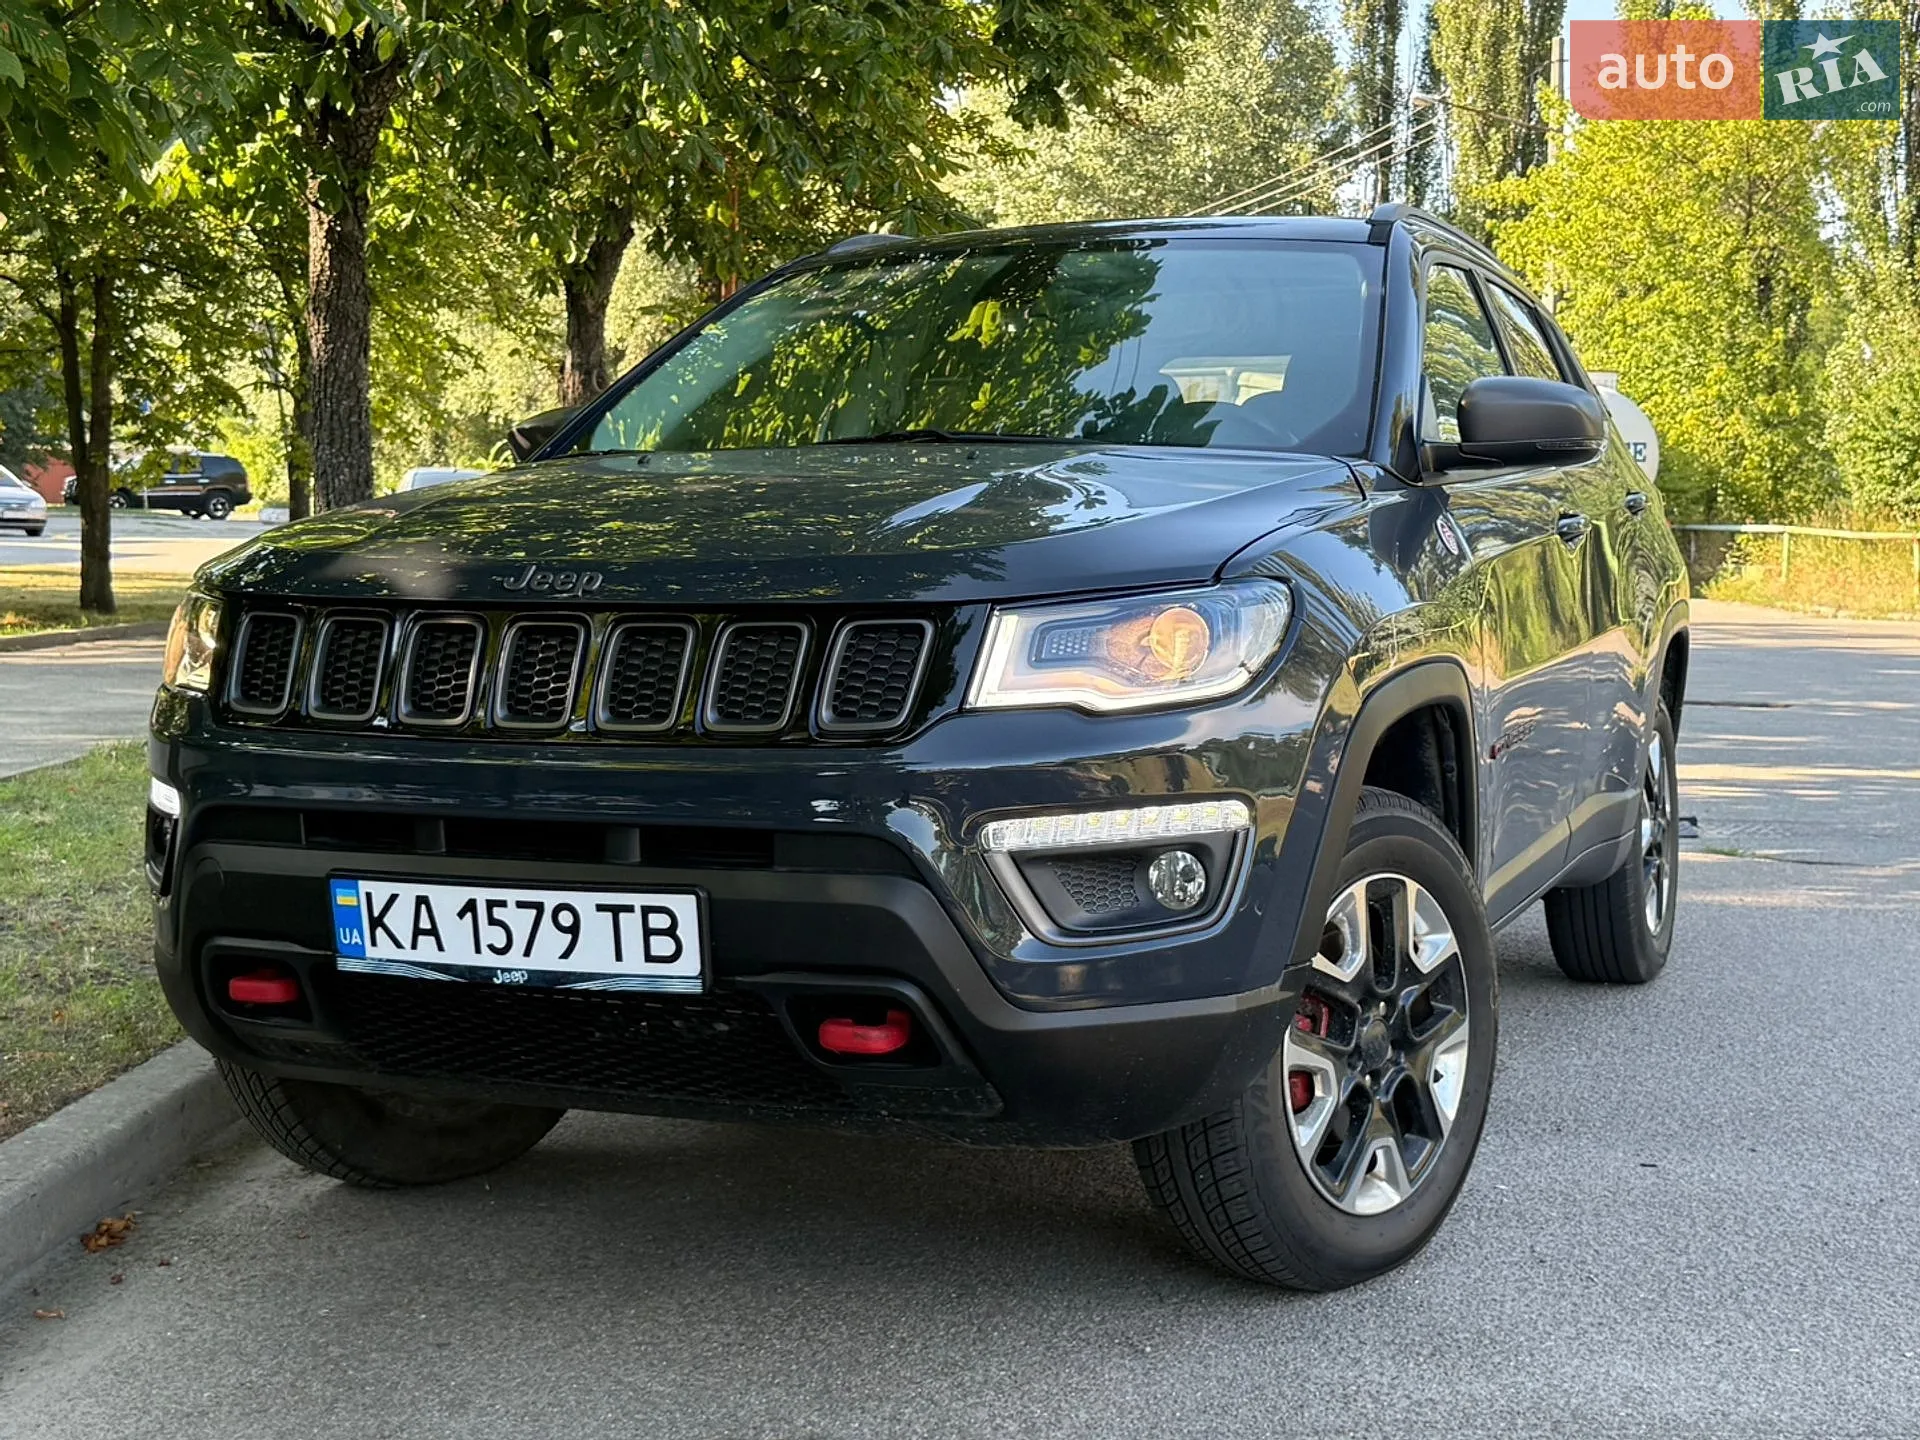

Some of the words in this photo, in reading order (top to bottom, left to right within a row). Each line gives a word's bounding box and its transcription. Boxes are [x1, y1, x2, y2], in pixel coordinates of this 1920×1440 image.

[502, 564, 603, 600] Jeep
[340, 926, 363, 946] UA
[364, 891, 446, 952] KA
[456, 898, 582, 960] 1579
[595, 903, 684, 964] TB
[492, 968, 529, 985] Jeep
